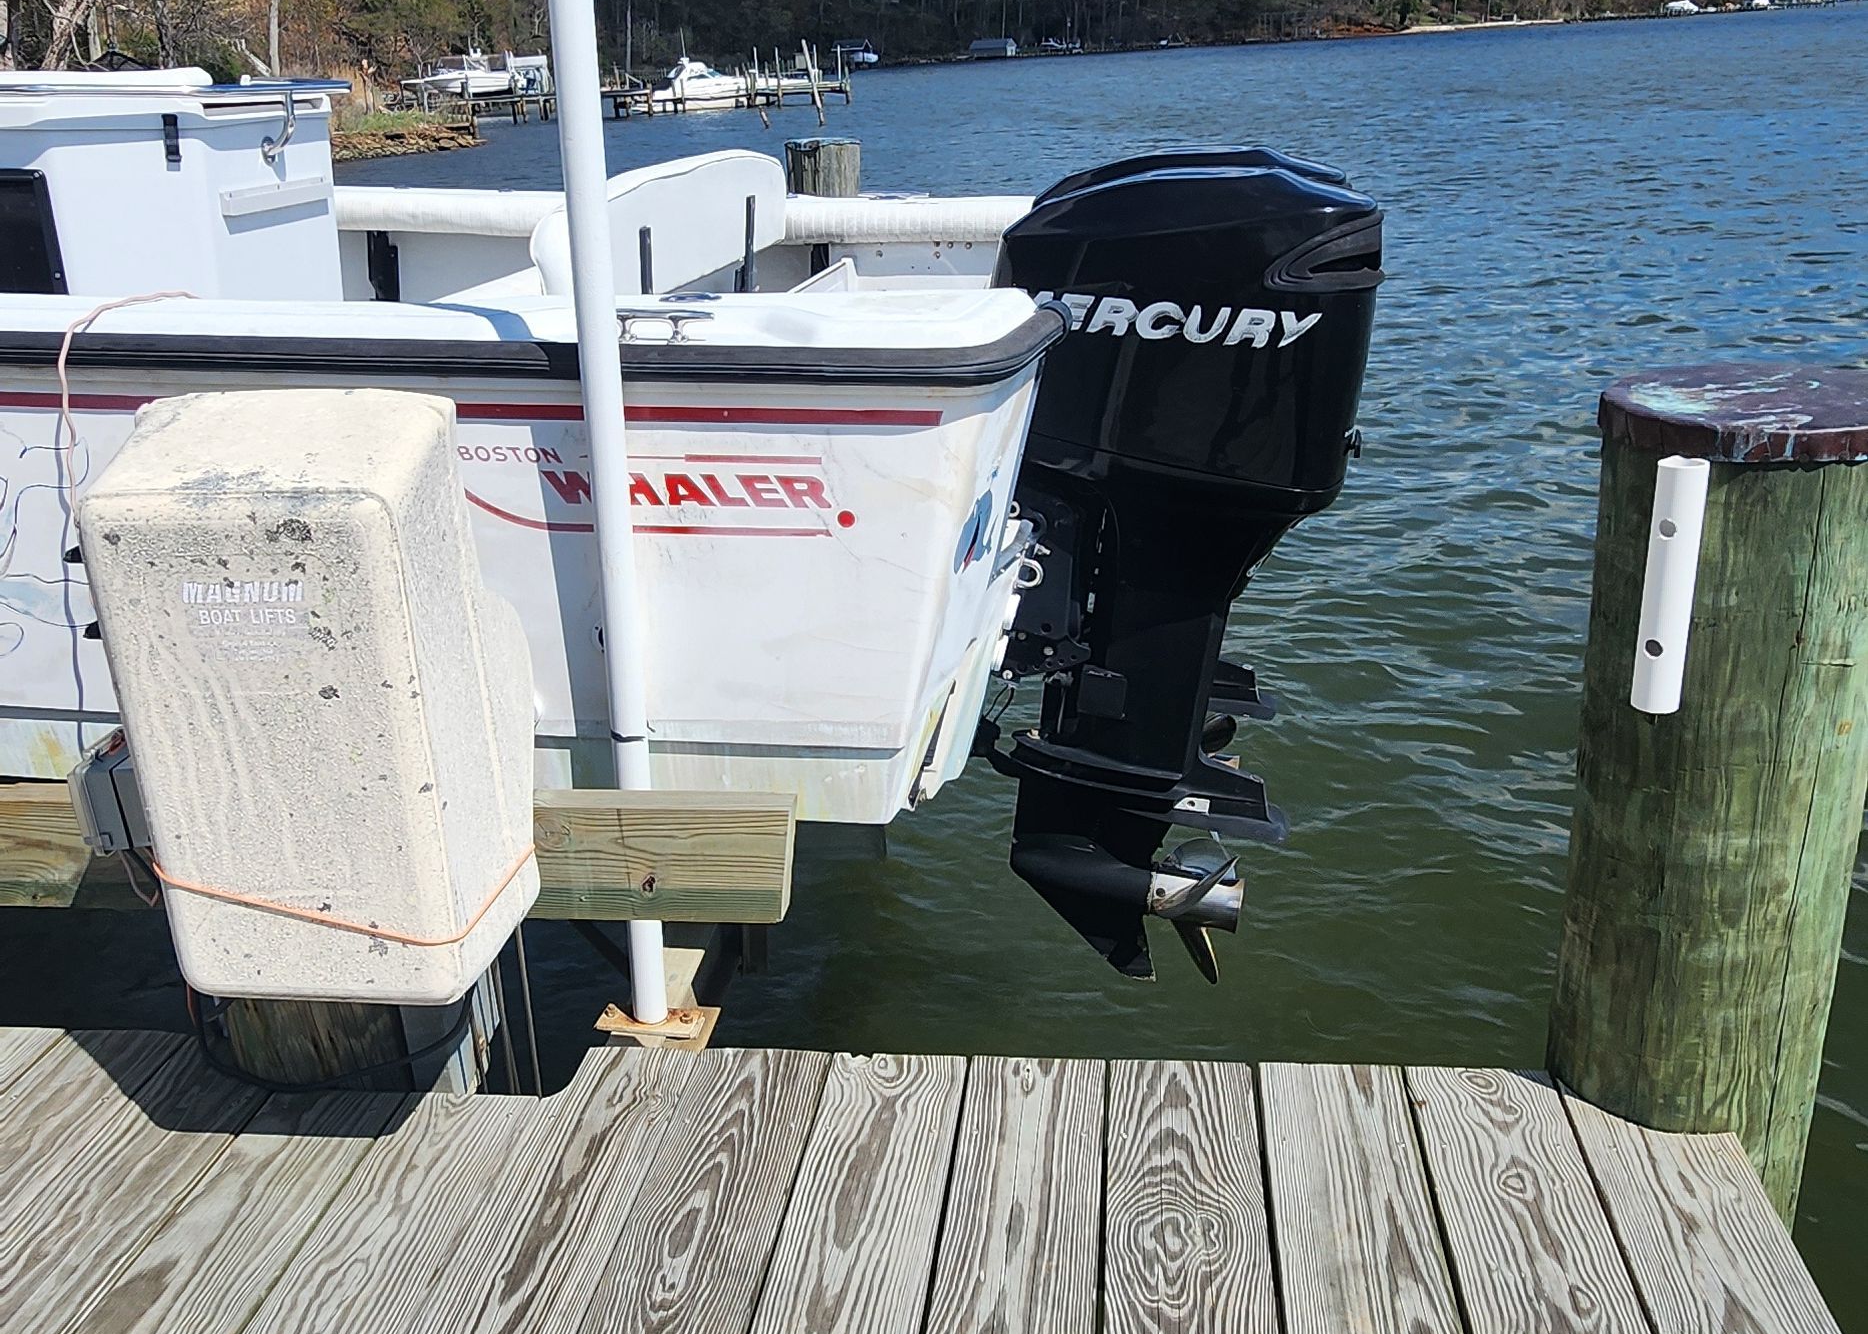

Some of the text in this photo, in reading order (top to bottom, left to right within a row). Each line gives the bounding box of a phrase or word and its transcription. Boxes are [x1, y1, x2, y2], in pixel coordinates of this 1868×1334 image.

[1033, 290, 1323, 349] ERCURY
[457, 445, 563, 464] BOSTON
[182, 581, 304, 604] MAGNUM
[199, 608, 296, 625] BOAT LIFTS
